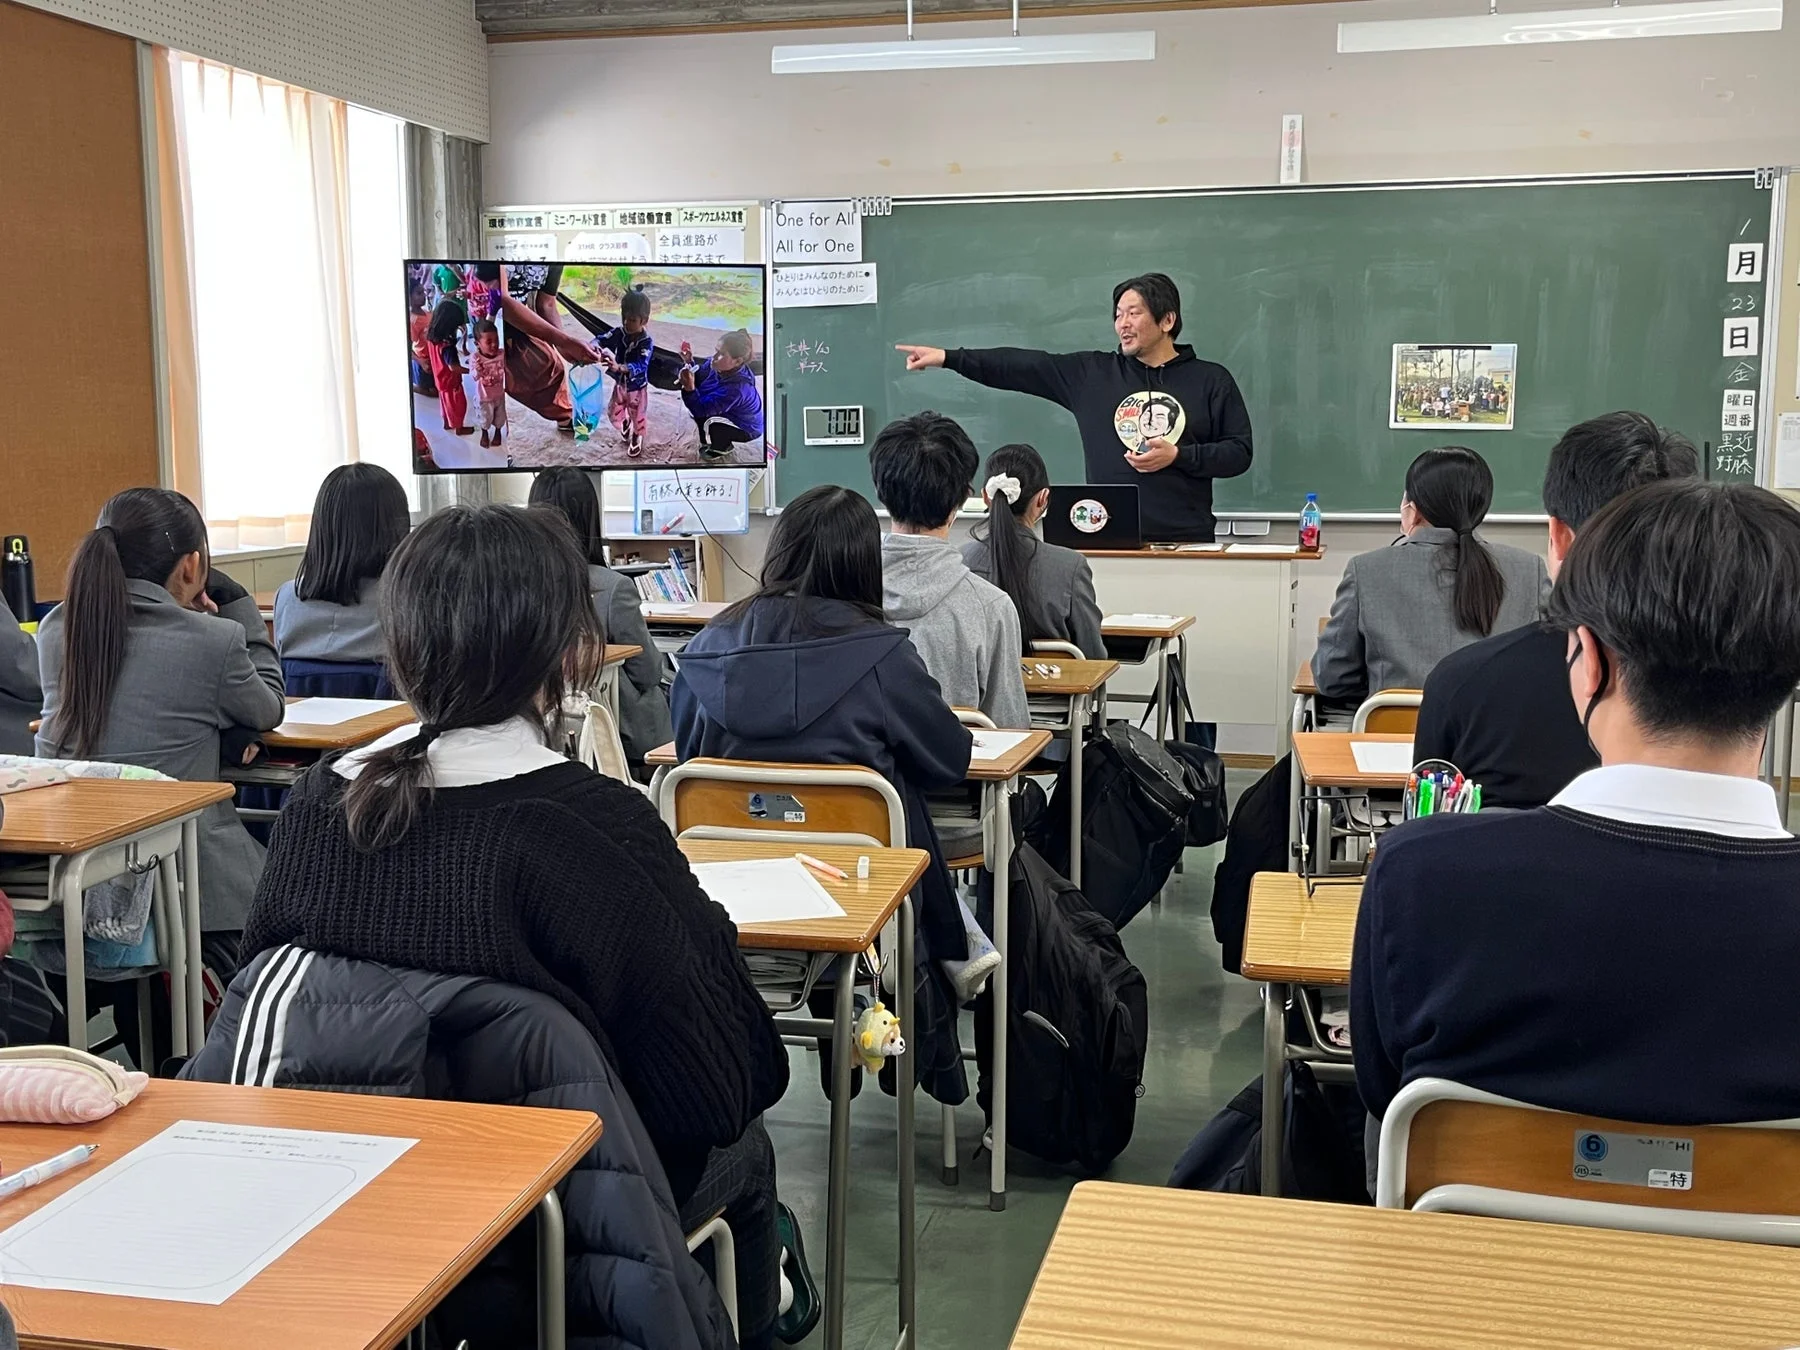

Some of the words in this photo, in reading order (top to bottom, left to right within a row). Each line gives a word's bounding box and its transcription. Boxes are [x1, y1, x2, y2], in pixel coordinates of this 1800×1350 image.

[619, 211, 672, 225] 地域協働宣言
[776, 212, 804, 227] One
[809, 212, 830, 226] for
[835, 211, 854, 226] All
[659, 234, 718, 247] 全員進路が
[776, 239, 793, 253] All
[799, 239, 819, 253] for
[824, 238, 854, 253] One
[1735, 250, 1756, 276] 月
[776, 270, 865, 283] ひとりはみんなのために
[776, 285, 865, 297] みんなはひとりのために
[1731, 294, 1756, 312] 23
[1729, 326, 1749, 349] 日
[1727, 361, 1756, 383] 金
[1120, 396, 1145, 408] BIG
[1726, 394, 1754, 407] 曜日
[1115, 407, 1141, 422] SMILE
[1723, 413, 1752, 427] 週番
[1586, 1134, 1601, 1153] 6
[1670, 1171, 1688, 1188] 特
